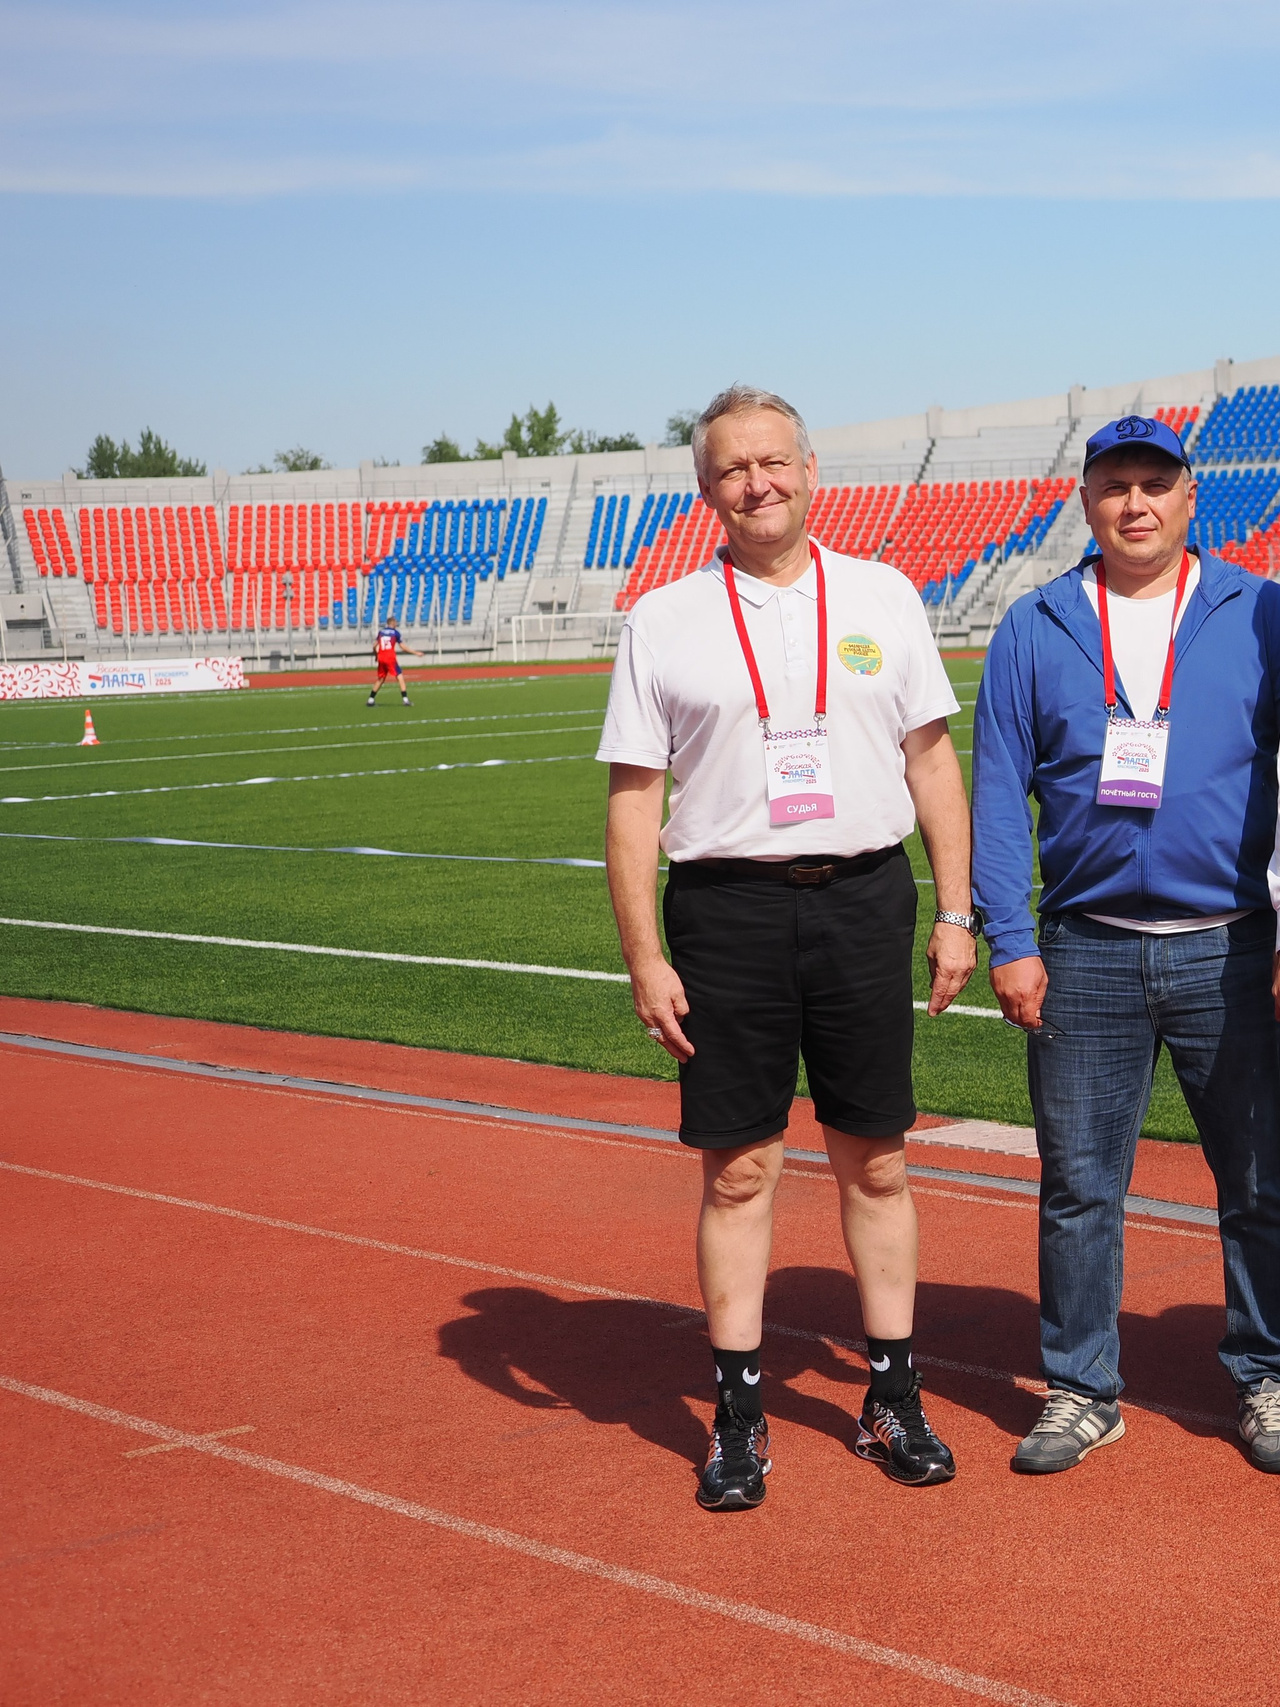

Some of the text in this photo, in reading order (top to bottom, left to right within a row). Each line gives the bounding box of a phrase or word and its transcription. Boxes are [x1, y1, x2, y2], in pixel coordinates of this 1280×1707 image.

[101, 673, 146, 688] ЛАПТА
[1137, 791, 1158, 799] ГОСТЬ
[786, 803, 817, 814] СУДЬЯ
